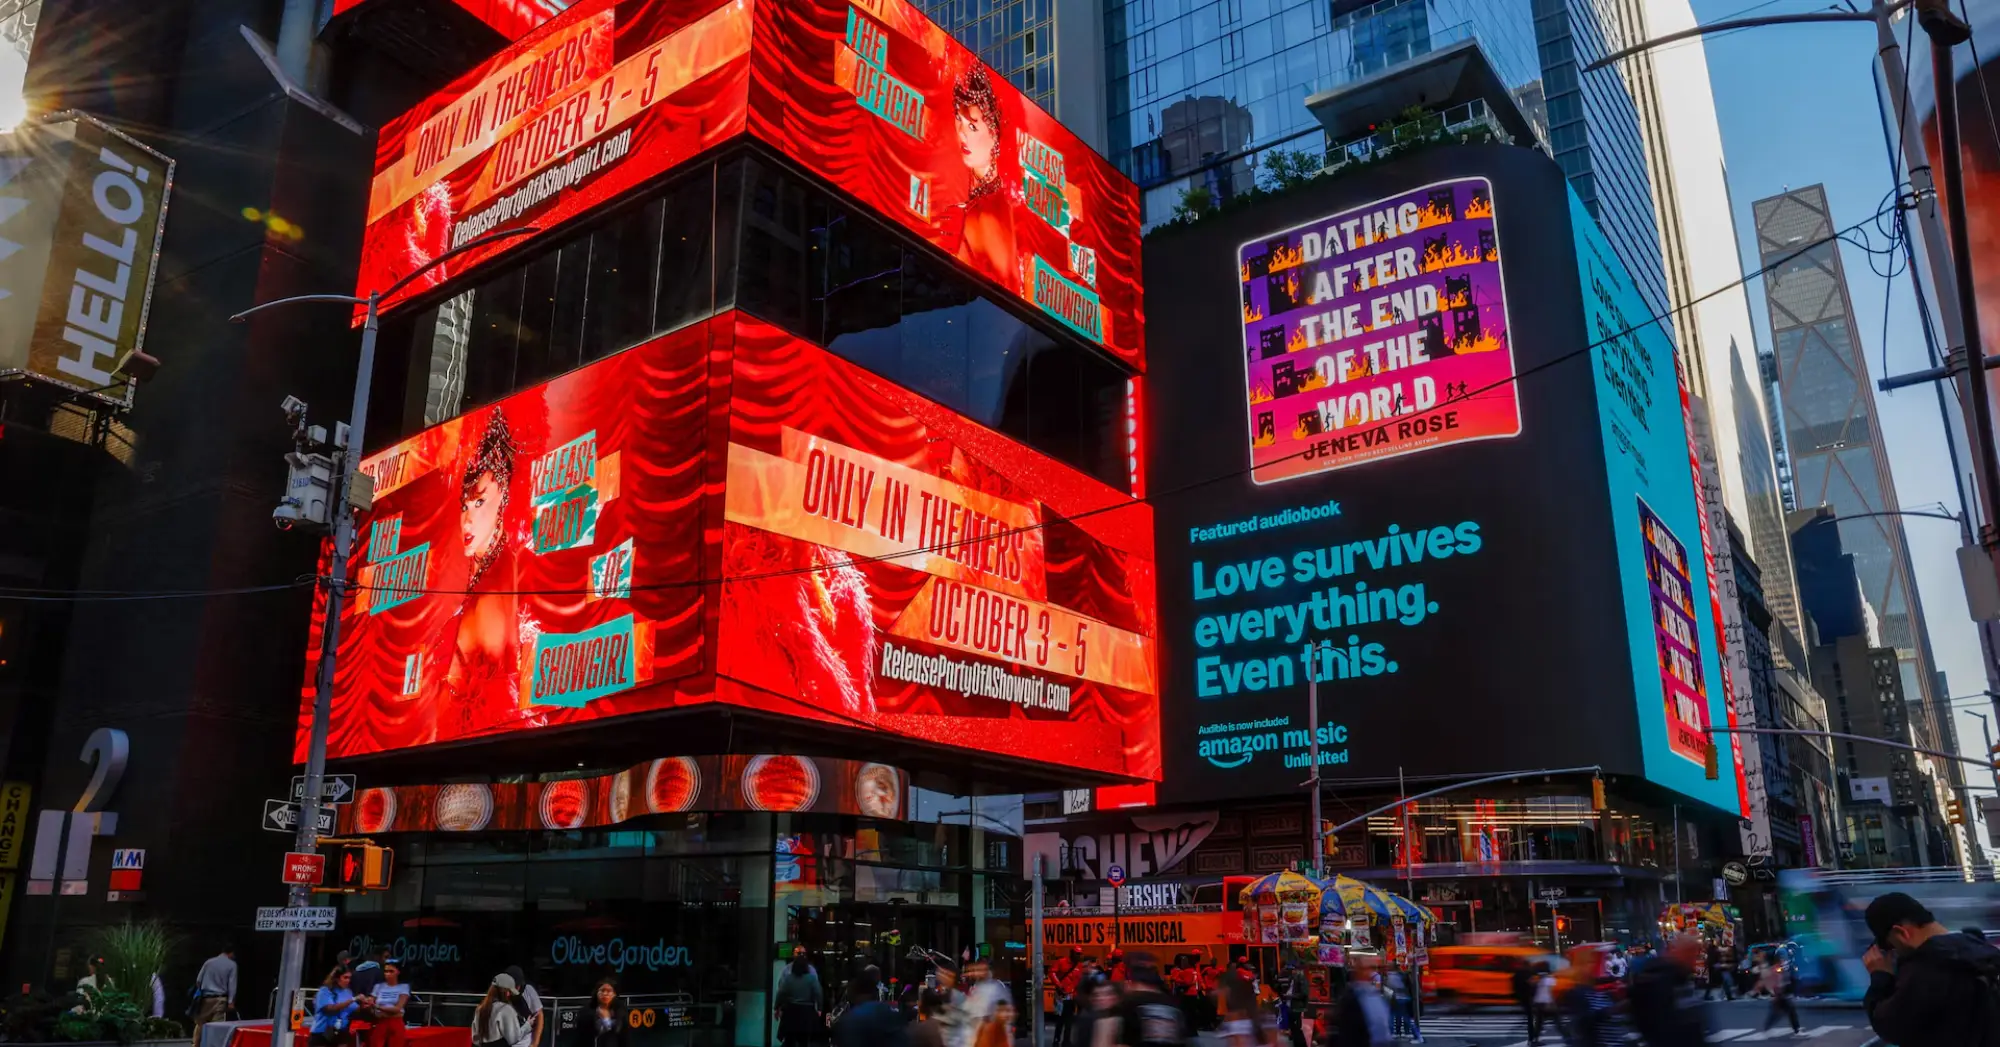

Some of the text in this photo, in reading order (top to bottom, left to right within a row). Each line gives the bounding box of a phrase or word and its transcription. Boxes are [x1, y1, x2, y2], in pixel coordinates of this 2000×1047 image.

[850, 14, 884, 65] THE
[413, 27, 594, 178] ONLY IN THEATERS
[492, 91, 591, 191] OCTOBER
[594, 76, 615, 134] 3
[640, 48, 662, 108] 5
[854, 58, 925, 139] OFFICIAL
[1017, 131, 1065, 189] RELEASE
[451, 128, 632, 250] ReleasePartyOfAShowgirl.com
[914, 179, 928, 211] A
[1026, 181, 1063, 226] PARTY
[1302, 202, 1420, 263] DATING
[56, 147, 150, 386] HELLO!
[1077, 249, 1093, 278] OF
[1313, 246, 1418, 305] AFTER
[1037, 269, 1099, 339] SHOWGIRL
[1300, 284, 1438, 348] THE END
[1315, 330, 1431, 387] OF THE
[1317, 376, 1437, 432] WORLD
[1302, 411, 1459, 461] JENEVA ROSE
[374, 451, 409, 493] SWIFT
[532, 438, 597, 498] RELEASE
[371, 515, 400, 562] THE
[534, 496, 590, 551] PARTY
[802, 449, 1025, 584] ONLY IN THEATERS
[1190, 500, 1341, 544] Featured audiobook
[370, 551, 428, 607] OFFICIAL
[602, 551, 627, 597] OF
[1193, 521, 1482, 600] Love survives
[929, 577, 1029, 661] OCTOBER
[1036, 611, 1051, 667] 3
[1074, 622, 1087, 676] 5
[1194, 581, 1439, 648] everything.
[406, 655, 420, 693] A
[534, 632, 630, 698] SHOWGIRL
[881, 641, 1070, 713] ReleasePartyOfAShowgirl.com
[1197, 634, 1399, 698] Even this.
[1198, 716, 1289, 735] Audible is now included
[1198, 721, 1348, 758] amazon music
[325, 784, 343, 795] WAY
[277, 811, 328, 828] ONE AY
[291, 863, 317, 873] WRONG
[295, 872, 311, 881] WAY
[258, 907, 335, 919] PEDESTRIAN FLOW ZONE
[1118, 882, 1193, 908] ERSHEY'S
[257, 919, 300, 929] KEEP MOVING
[1044, 922, 1105, 945] WORLD'S
[1123, 920, 1187, 944] MUSICAL
[393, 936, 462, 968] Garden
[552, 935, 693, 973] Olive Garden
